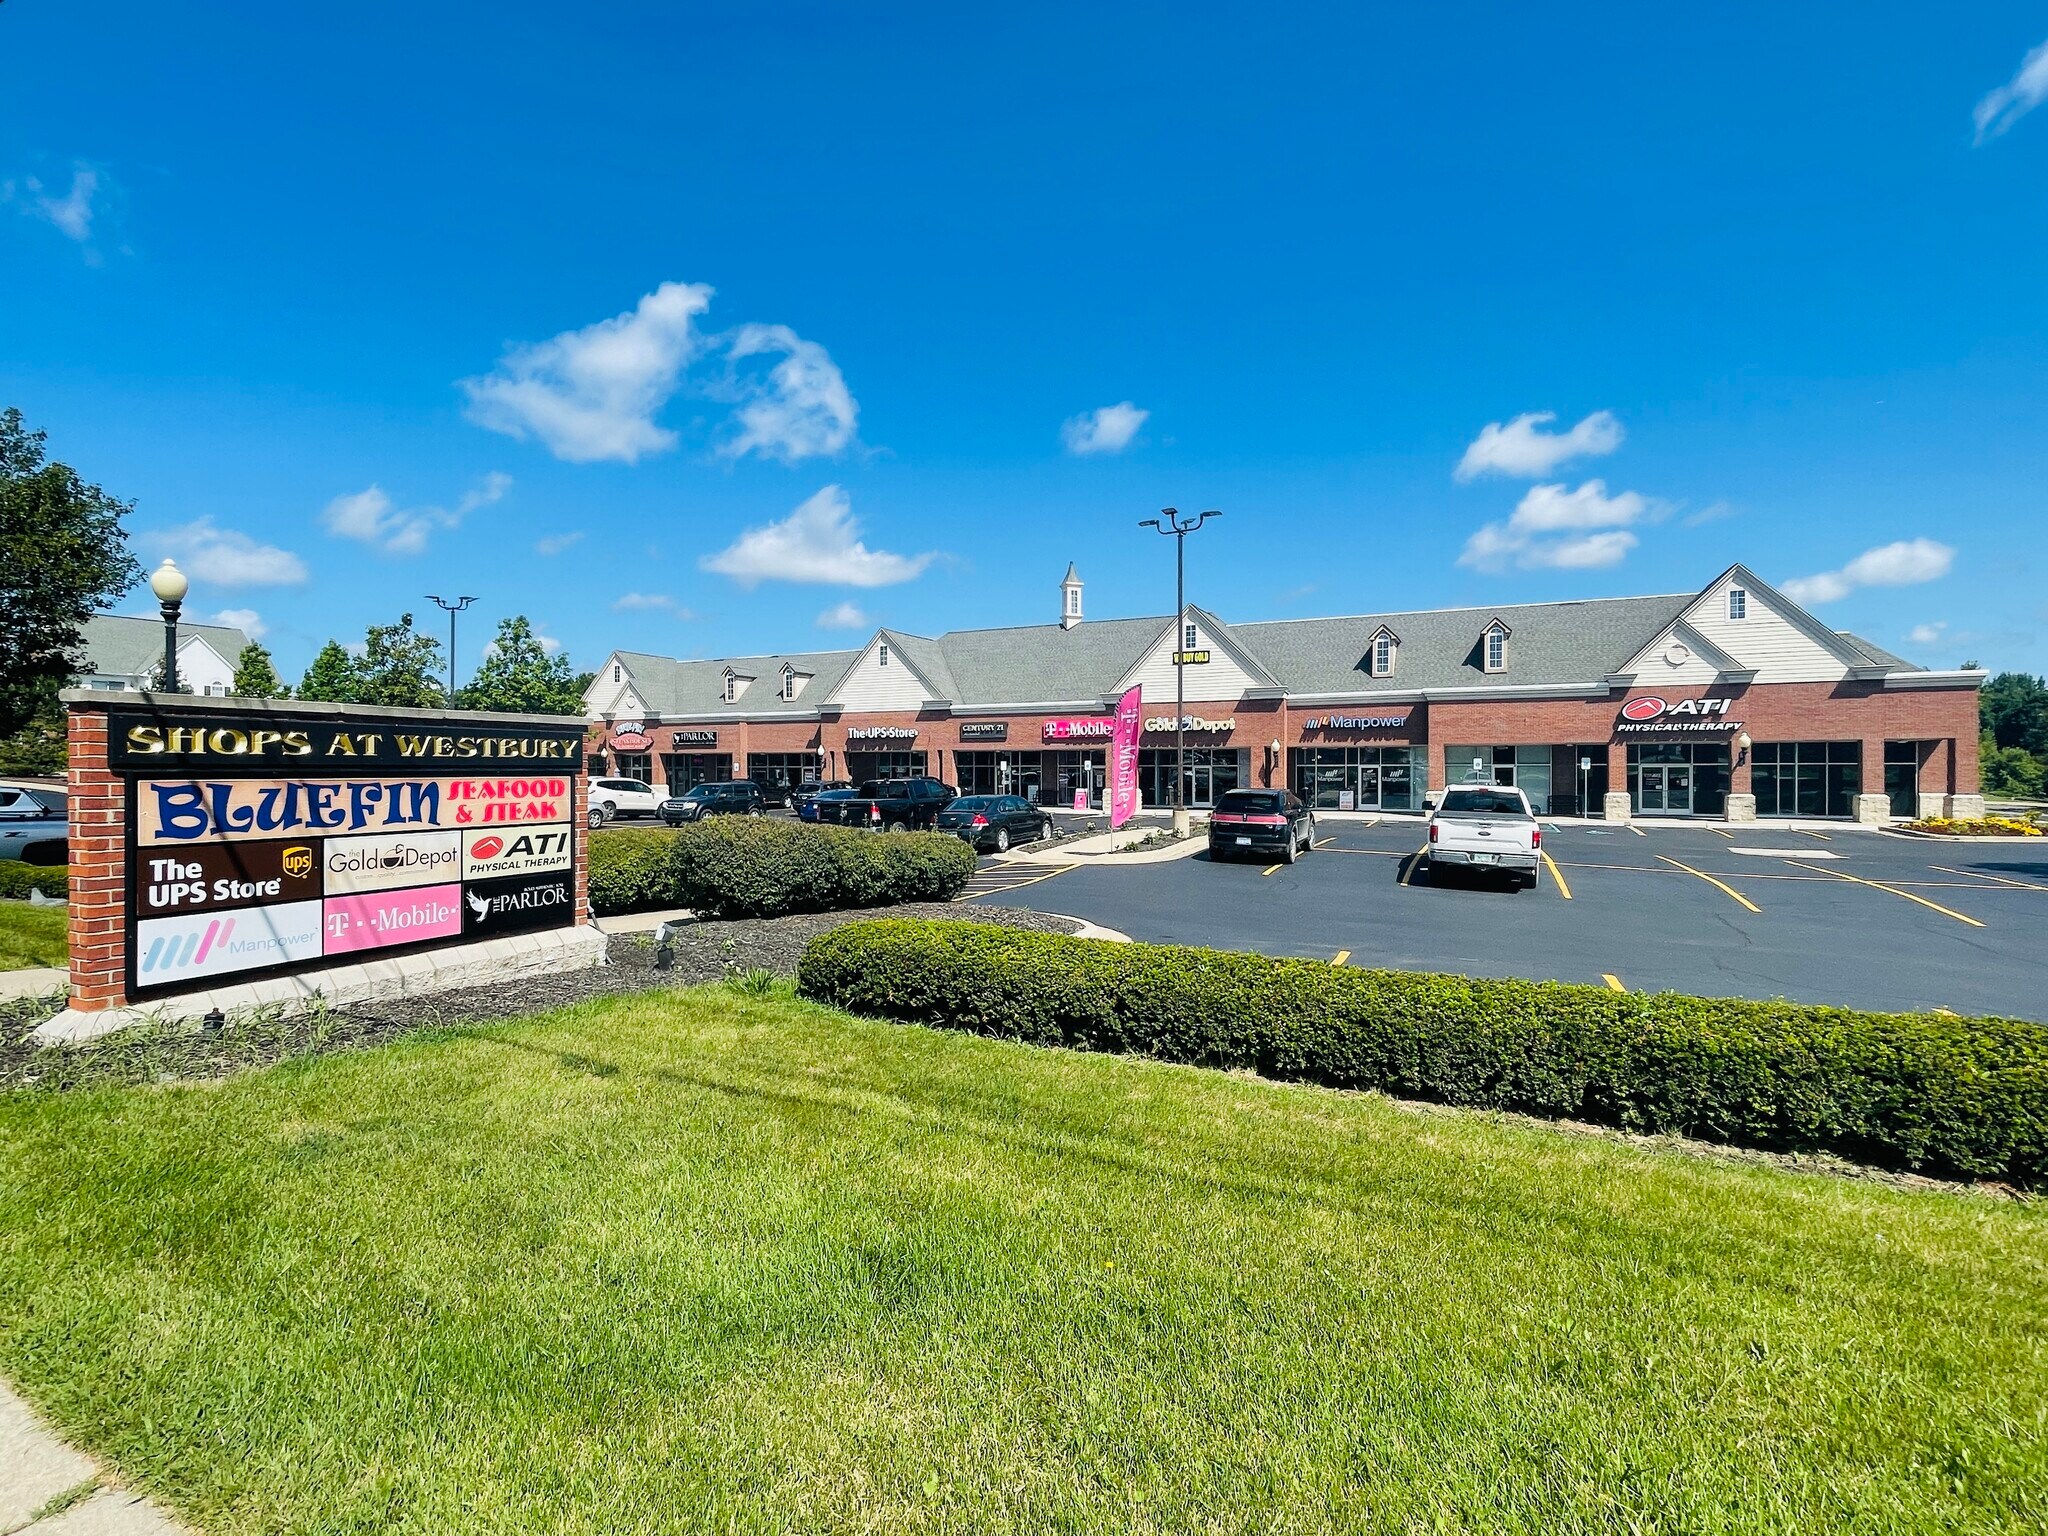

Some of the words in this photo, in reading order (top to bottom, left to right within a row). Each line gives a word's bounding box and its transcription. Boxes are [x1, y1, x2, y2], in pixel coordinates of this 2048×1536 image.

[1194, 652, 1209, 662] GOLD
[1669, 699, 1732, 715] ATI
[962, 724, 995, 732] CENTURY
[1193, 717, 1235, 734] Depot
[1330, 716, 1406, 730] Manpower
[1617, 723, 1680, 732] PHYSICAL
[1681, 722, 1743, 731] THERAPY
[127, 724, 313, 756] SHOPS
[325, 732, 383, 757] AT
[393, 734, 579, 759] WESTBURY
[683, 731, 715, 741] PARLOR
[848, 727, 866, 739] The
[868, 727, 887, 738] UPS
[890, 727, 914, 738] Store
[447, 779, 565, 801] SEAFOOD
[151, 780, 441, 840] BLUEFIN
[455, 804, 474, 824] &
[482, 801, 558, 823] STEAK
[349, 849, 360, 857] the
[503, 832, 568, 858] ATI
[285, 855, 310, 873] ups
[329, 848, 378, 873] Gold
[406, 847, 457, 870] Depot
[470, 861, 521, 874] PHYSICAL
[524, 856, 568, 868] THERAPY
[149, 858, 202, 881] The
[149, 881, 207, 908] UPS
[213, 878, 281, 901] Store
[492, 896, 500, 913] THE
[500, 887, 569, 912] PARLOR
[230, 931, 316, 954] Manpower
